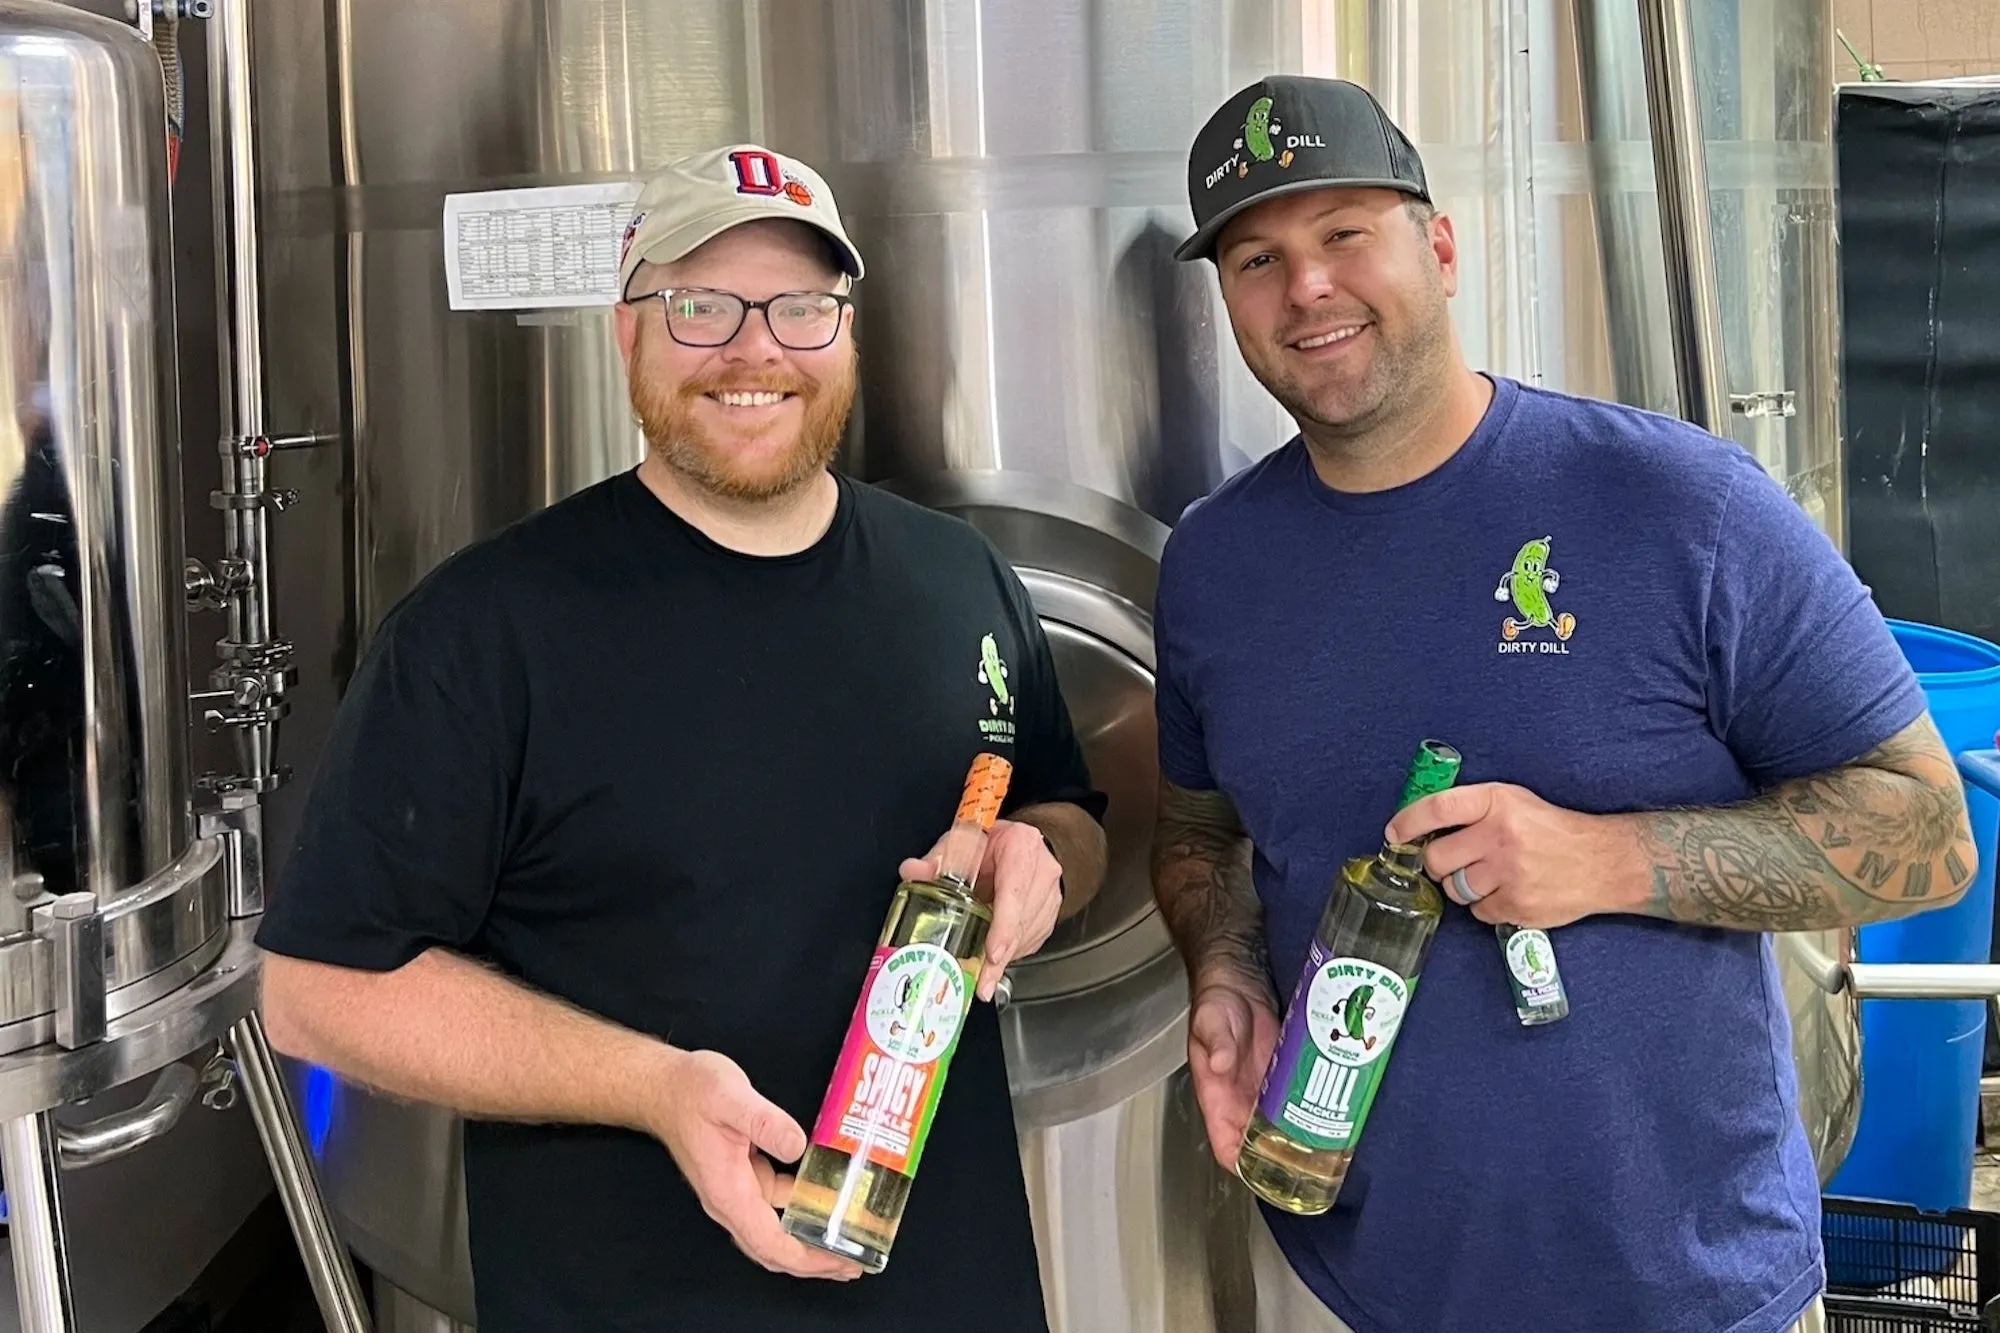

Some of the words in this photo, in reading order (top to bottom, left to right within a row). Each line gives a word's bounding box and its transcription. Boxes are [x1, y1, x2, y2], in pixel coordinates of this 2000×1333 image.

[727, 150, 785, 197] D
[1205, 153, 1240, 190] DIRTY
[1286, 134, 1327, 149] DILL
[1497, 641, 1538, 654] DIRTY
[1539, 641, 1570, 655] DILL
[887, 950, 936, 973] DIRTY
[938, 959, 962, 997] DILL
[1326, 964, 1376, 980] DIRTY
[1378, 976, 1406, 1001] DILL
[853, 1052, 928, 1120] SPICY
[1302, 1055, 1360, 1113] DILL
[849, 1102, 913, 1135] PICKLE
[1299, 1099, 1350, 1121] PICKLE
